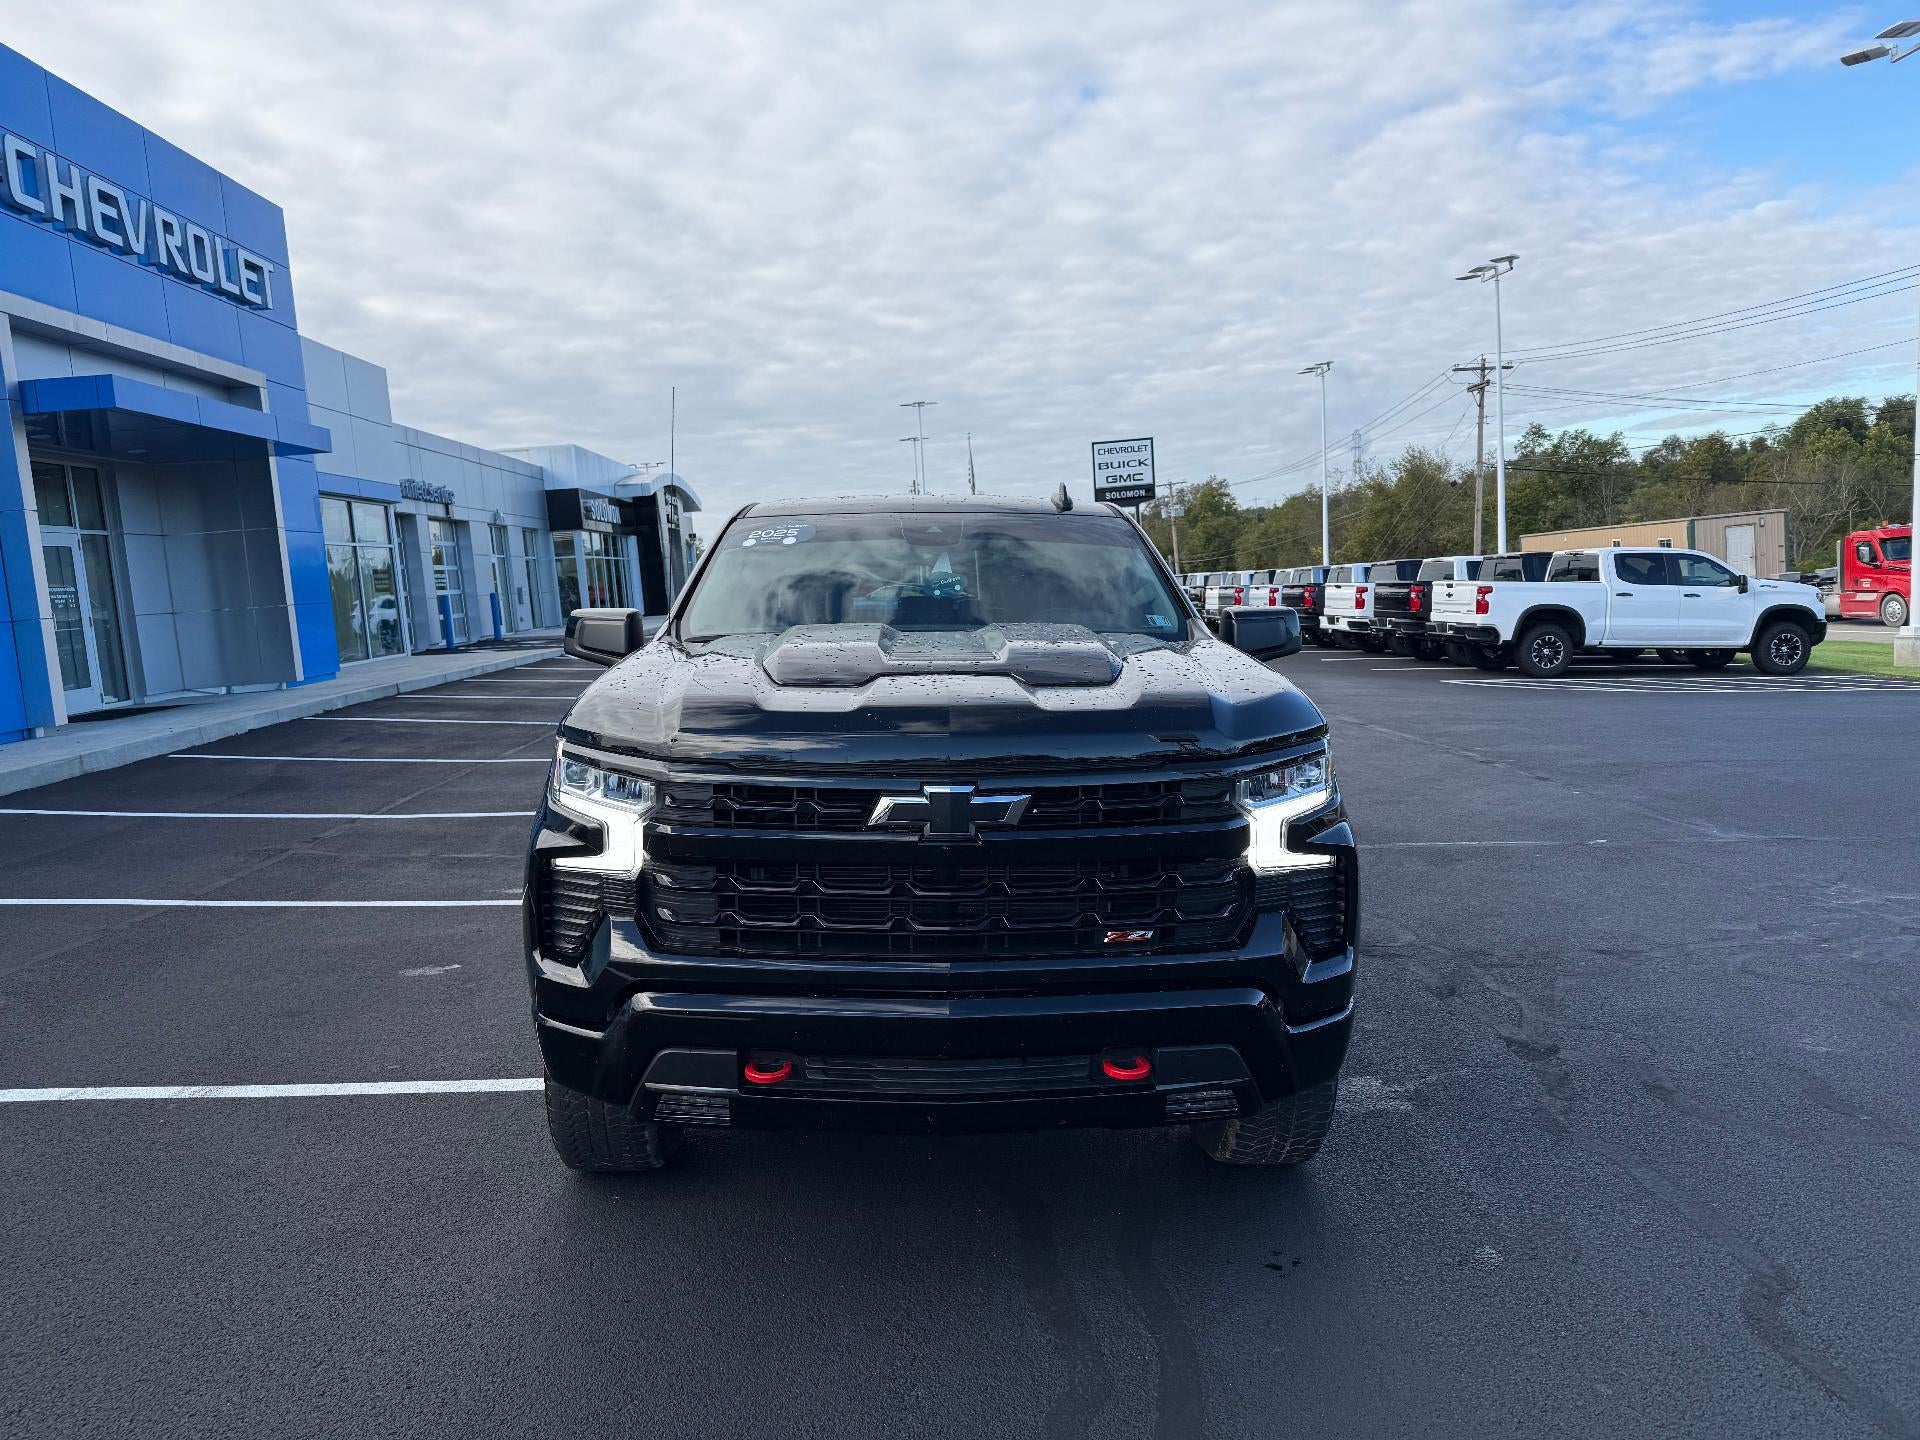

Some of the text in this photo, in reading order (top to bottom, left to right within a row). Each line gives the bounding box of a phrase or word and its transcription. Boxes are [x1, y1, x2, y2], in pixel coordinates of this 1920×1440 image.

[3, 133, 275, 310] CHEVROLET
[1097, 444, 1149, 456] CHEVROLET
[1097, 458, 1150, 471] BUICK
[1105, 472, 1144, 484] GMC
[1105, 489, 1146, 500] SOLOMON
[748, 528, 800, 539] 2025
